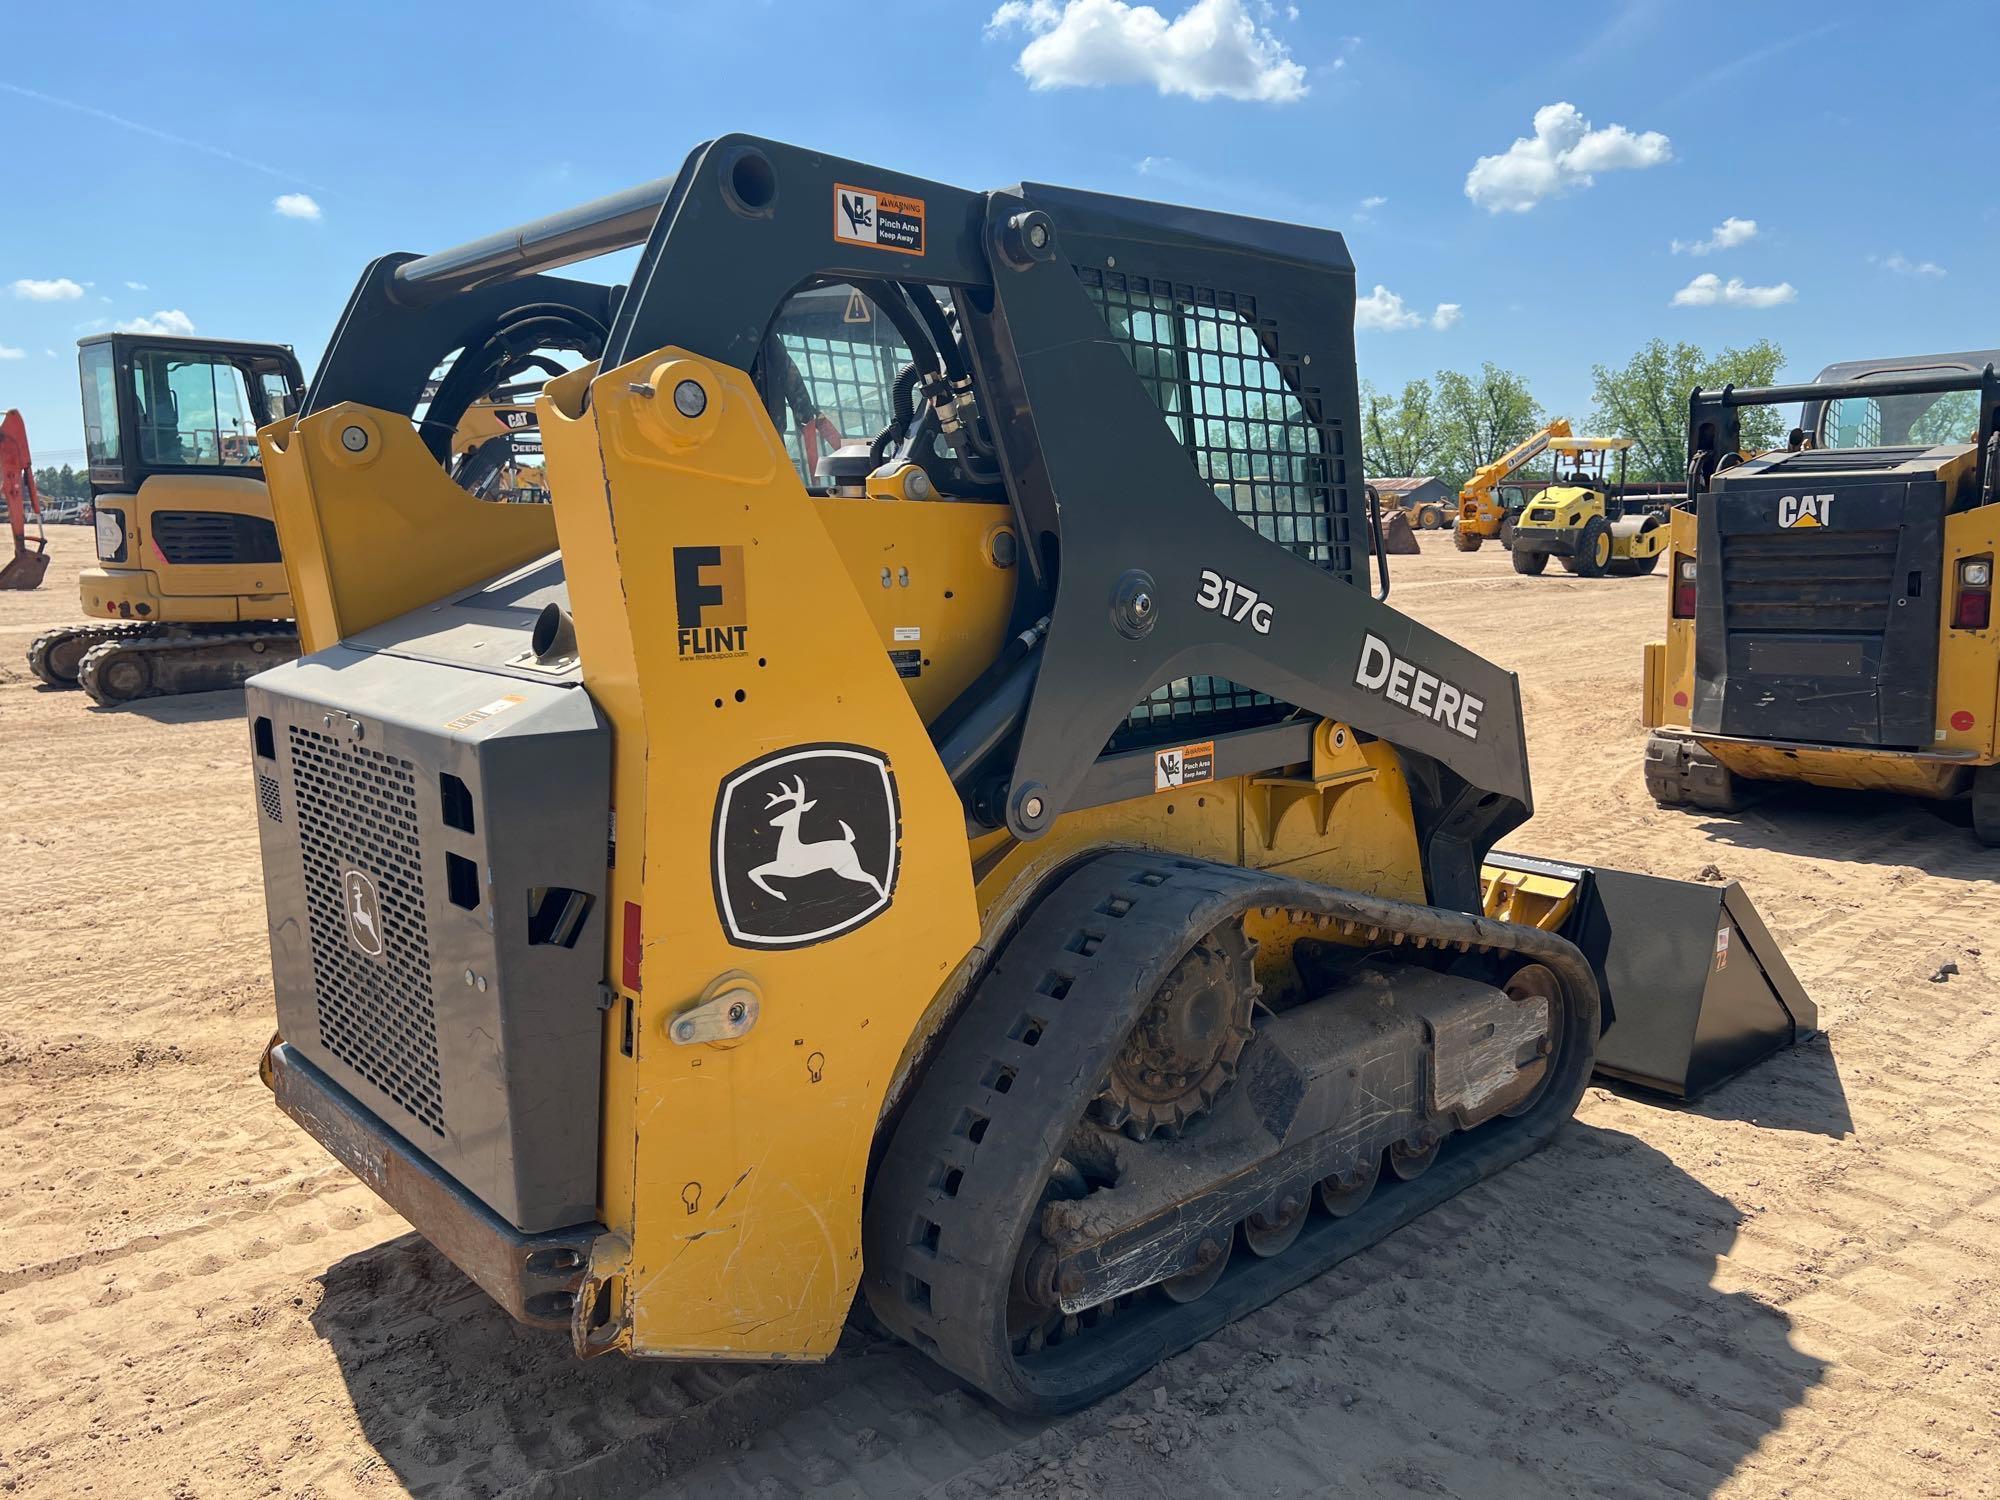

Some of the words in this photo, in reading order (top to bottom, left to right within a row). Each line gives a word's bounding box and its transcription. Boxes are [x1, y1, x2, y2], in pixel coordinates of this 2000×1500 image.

[887, 200, 921, 213] WARNING
[879, 217, 901, 230] Pinch
[902, 222, 920, 233] Area
[879, 229, 896, 241] Keep
[896, 233, 914, 244] Away
[507, 412, 528, 428] CAT
[511, 444, 545, 453] DEERE
[1778, 494, 1835, 529] CAT
[673, 546, 723, 629] F
[1196, 570, 1274, 634] 317G
[678, 626, 748, 655] FLINT
[1355, 633, 1484, 739] DEERE
[1184, 762, 1199, 770] Pinch
[1198, 760, 1211, 768] Area
